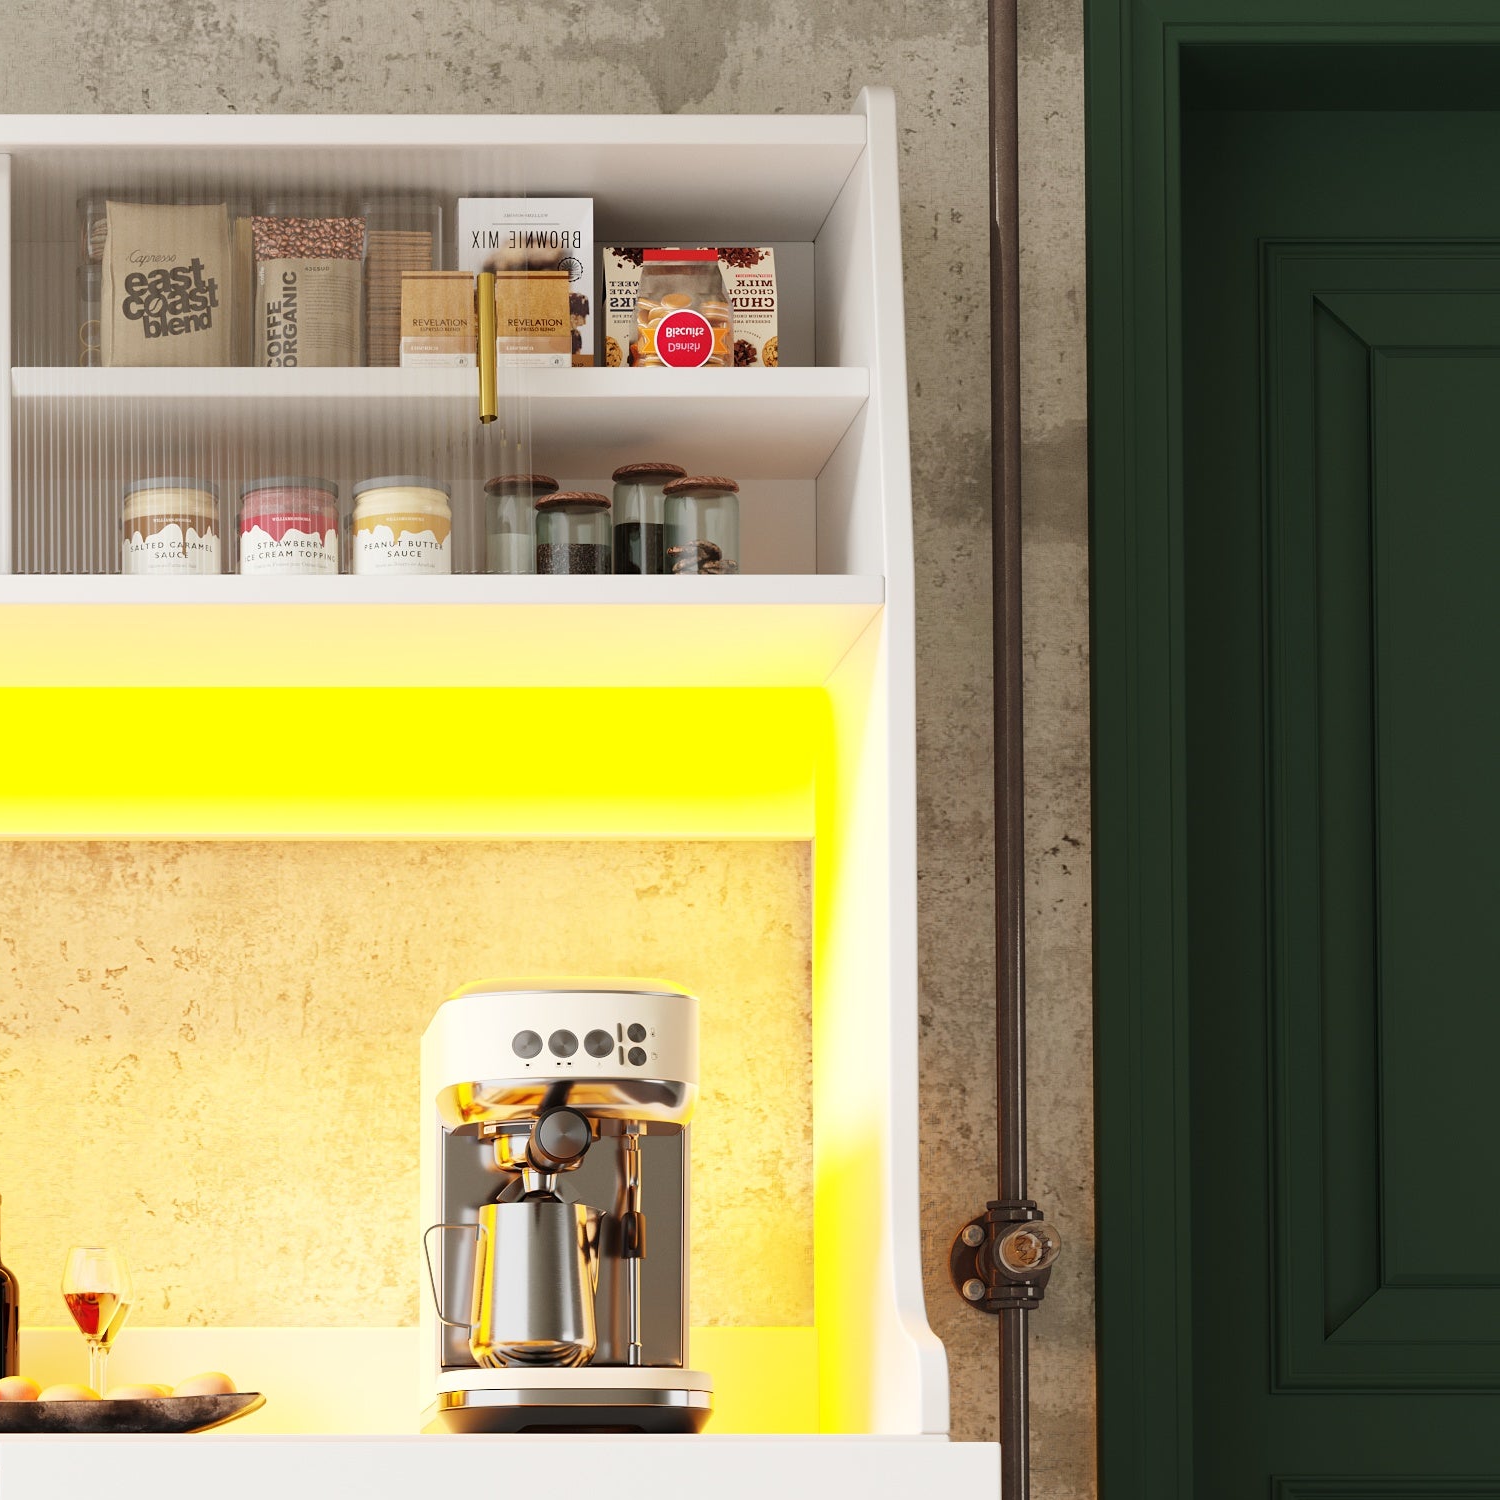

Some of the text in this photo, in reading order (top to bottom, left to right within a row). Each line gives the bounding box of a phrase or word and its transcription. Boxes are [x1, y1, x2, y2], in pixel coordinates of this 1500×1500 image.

[128, 249, 176, 267] Capresso
[125, 258, 205, 296] east
[122, 278, 219, 320] coast
[143, 306, 212, 338] blend
[283, 272, 297, 367] ORGANIC
[413, 319, 467, 327] REVELATION
[508, 319, 562, 327] REVELATION
[130, 541, 213, 552] SALTED CARAMEL
[257, 541, 323, 550] STRAWBERRY
[364, 541, 444, 550] PEANUT BUTTER
[244, 551, 336, 563] ICE CREAM TOPPING
[387, 550, 422, 558] SAUCE
